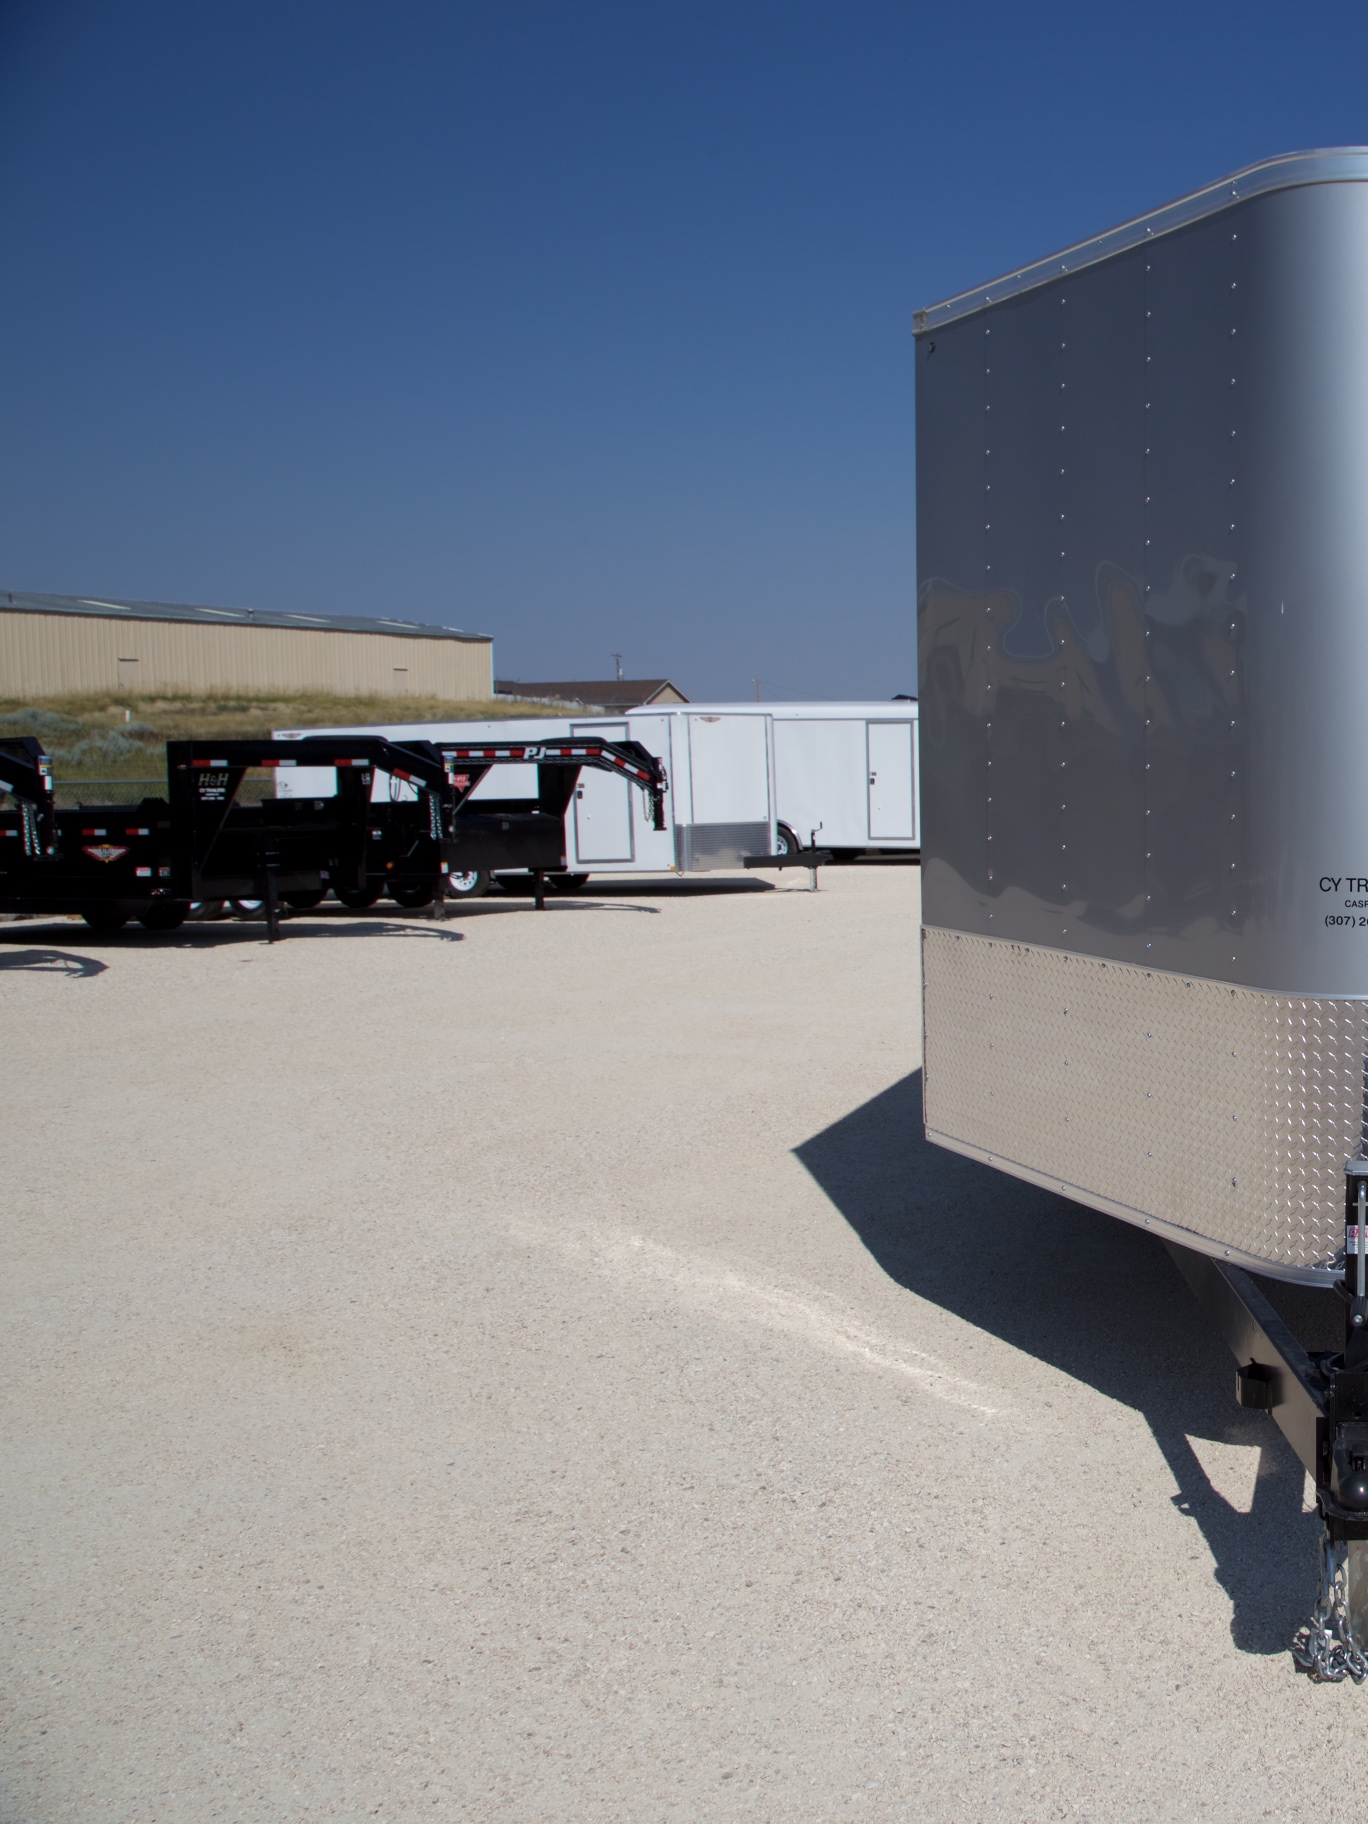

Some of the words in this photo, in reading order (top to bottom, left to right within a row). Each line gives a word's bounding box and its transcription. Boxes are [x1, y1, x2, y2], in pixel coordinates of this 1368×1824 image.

[523, 747, 546, 760] PJ
[1319, 876, 1342, 893] CY
[1324, 915, 1356, 929] (307)
